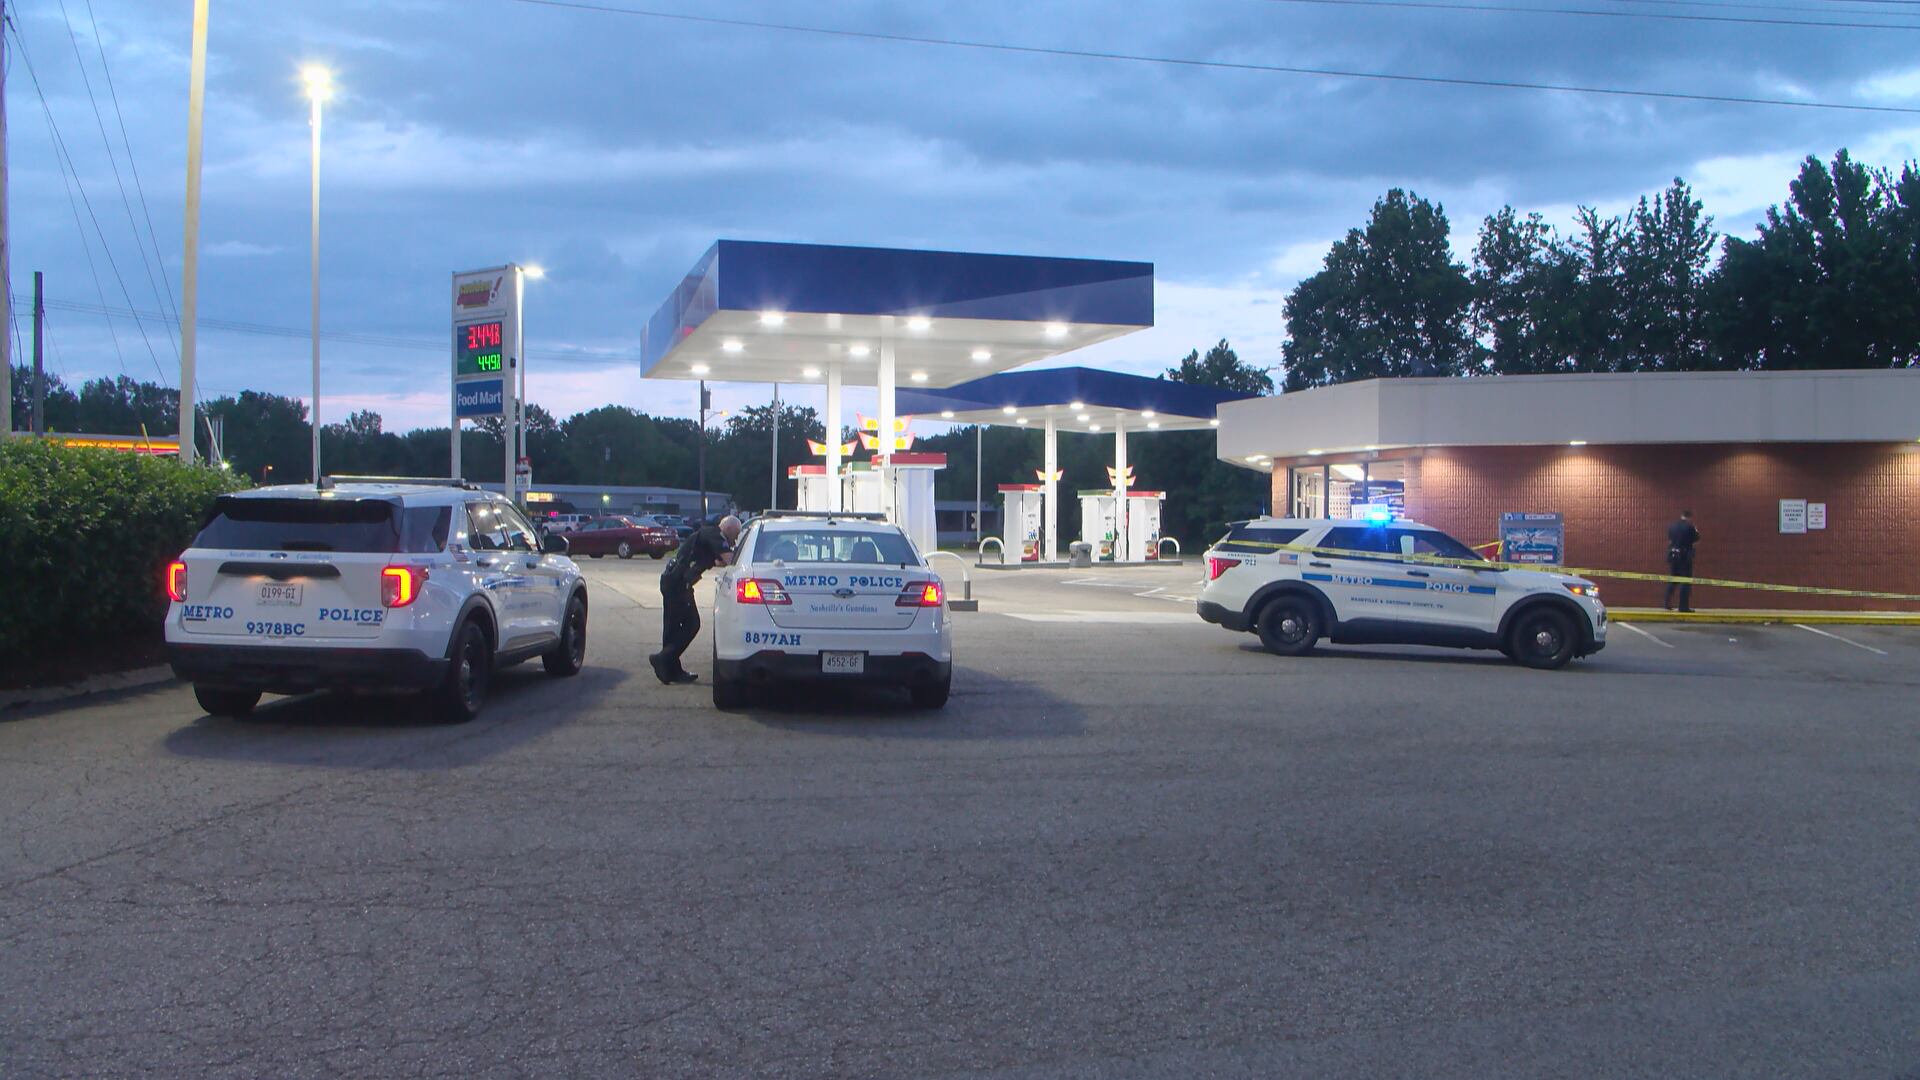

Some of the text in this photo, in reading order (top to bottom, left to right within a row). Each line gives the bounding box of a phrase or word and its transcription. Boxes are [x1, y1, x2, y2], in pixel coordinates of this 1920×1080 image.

[457, 391, 502, 407] Food Mart
[785, 575, 903, 588] METRO POLICE
[1331, 575, 1469, 593] METRO POLICE
[183, 605, 384, 622] METRO POLICE
[845, 604, 878, 613] Guardians
[246, 621, 305, 636] 9378BC
[745, 631, 802, 646] 8877AH
